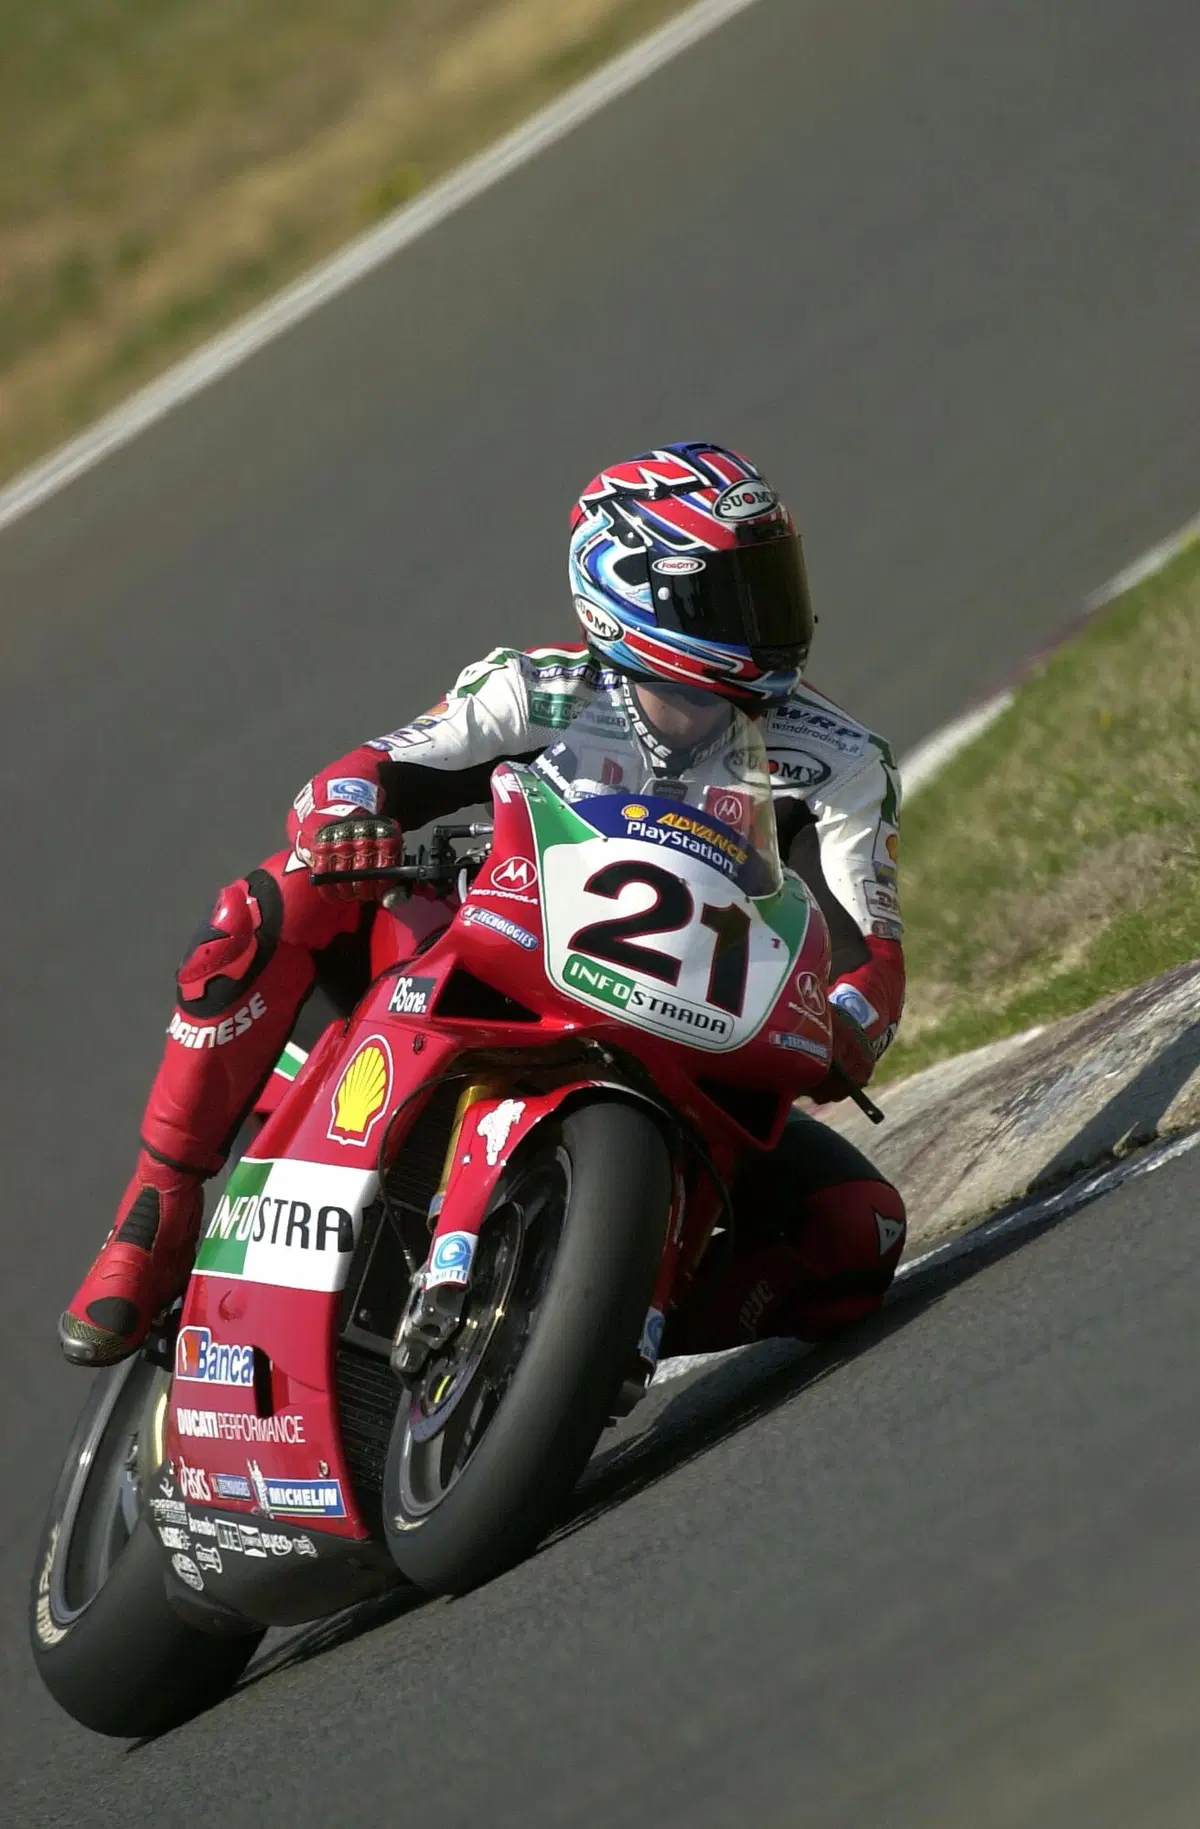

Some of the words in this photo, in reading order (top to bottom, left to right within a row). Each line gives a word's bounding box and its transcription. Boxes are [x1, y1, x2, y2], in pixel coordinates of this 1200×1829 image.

[776, 706, 863, 738] WRP
[732, 752, 822, 786] SUOMY
[627, 821, 735, 874] PlayStation
[656, 811, 749, 865] ADVANCE
[470, 888, 539, 905] MOTOROLA
[566, 859, 752, 1018] 21
[568, 961, 728, 1035] INFOSTRADA
[198, 1338, 254, 1385] Banca
[268, 1487, 338, 1507] MICHELIN
